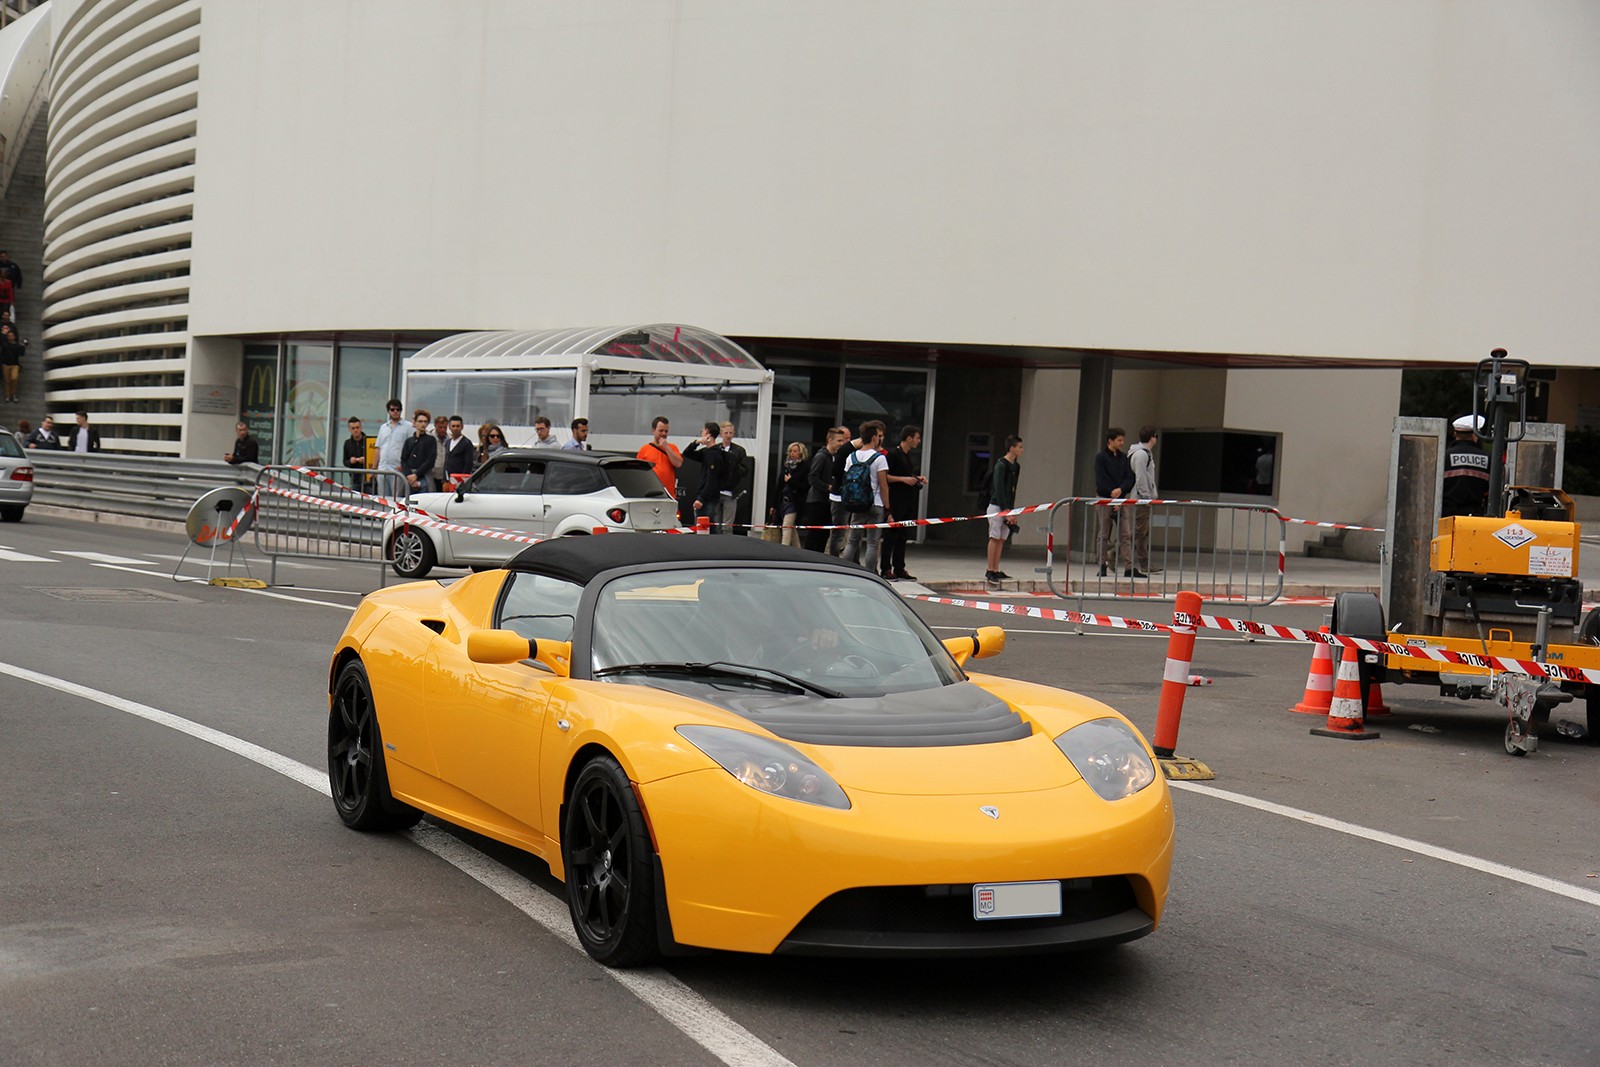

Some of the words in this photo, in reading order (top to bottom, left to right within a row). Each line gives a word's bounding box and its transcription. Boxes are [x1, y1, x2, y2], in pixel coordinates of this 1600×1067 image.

[1453, 455, 1487, 467] POLICE
[1175, 612, 1201, 626] POLICE
[1237, 620, 1266, 635] POLICE
[1305, 633, 1335, 645] POLICE
[1376, 641, 1411, 656] POLICE
[1456, 652, 1493, 668] POLICE
[1544, 664, 1585, 681] POLICE
[980, 901, 993, 910] MC
